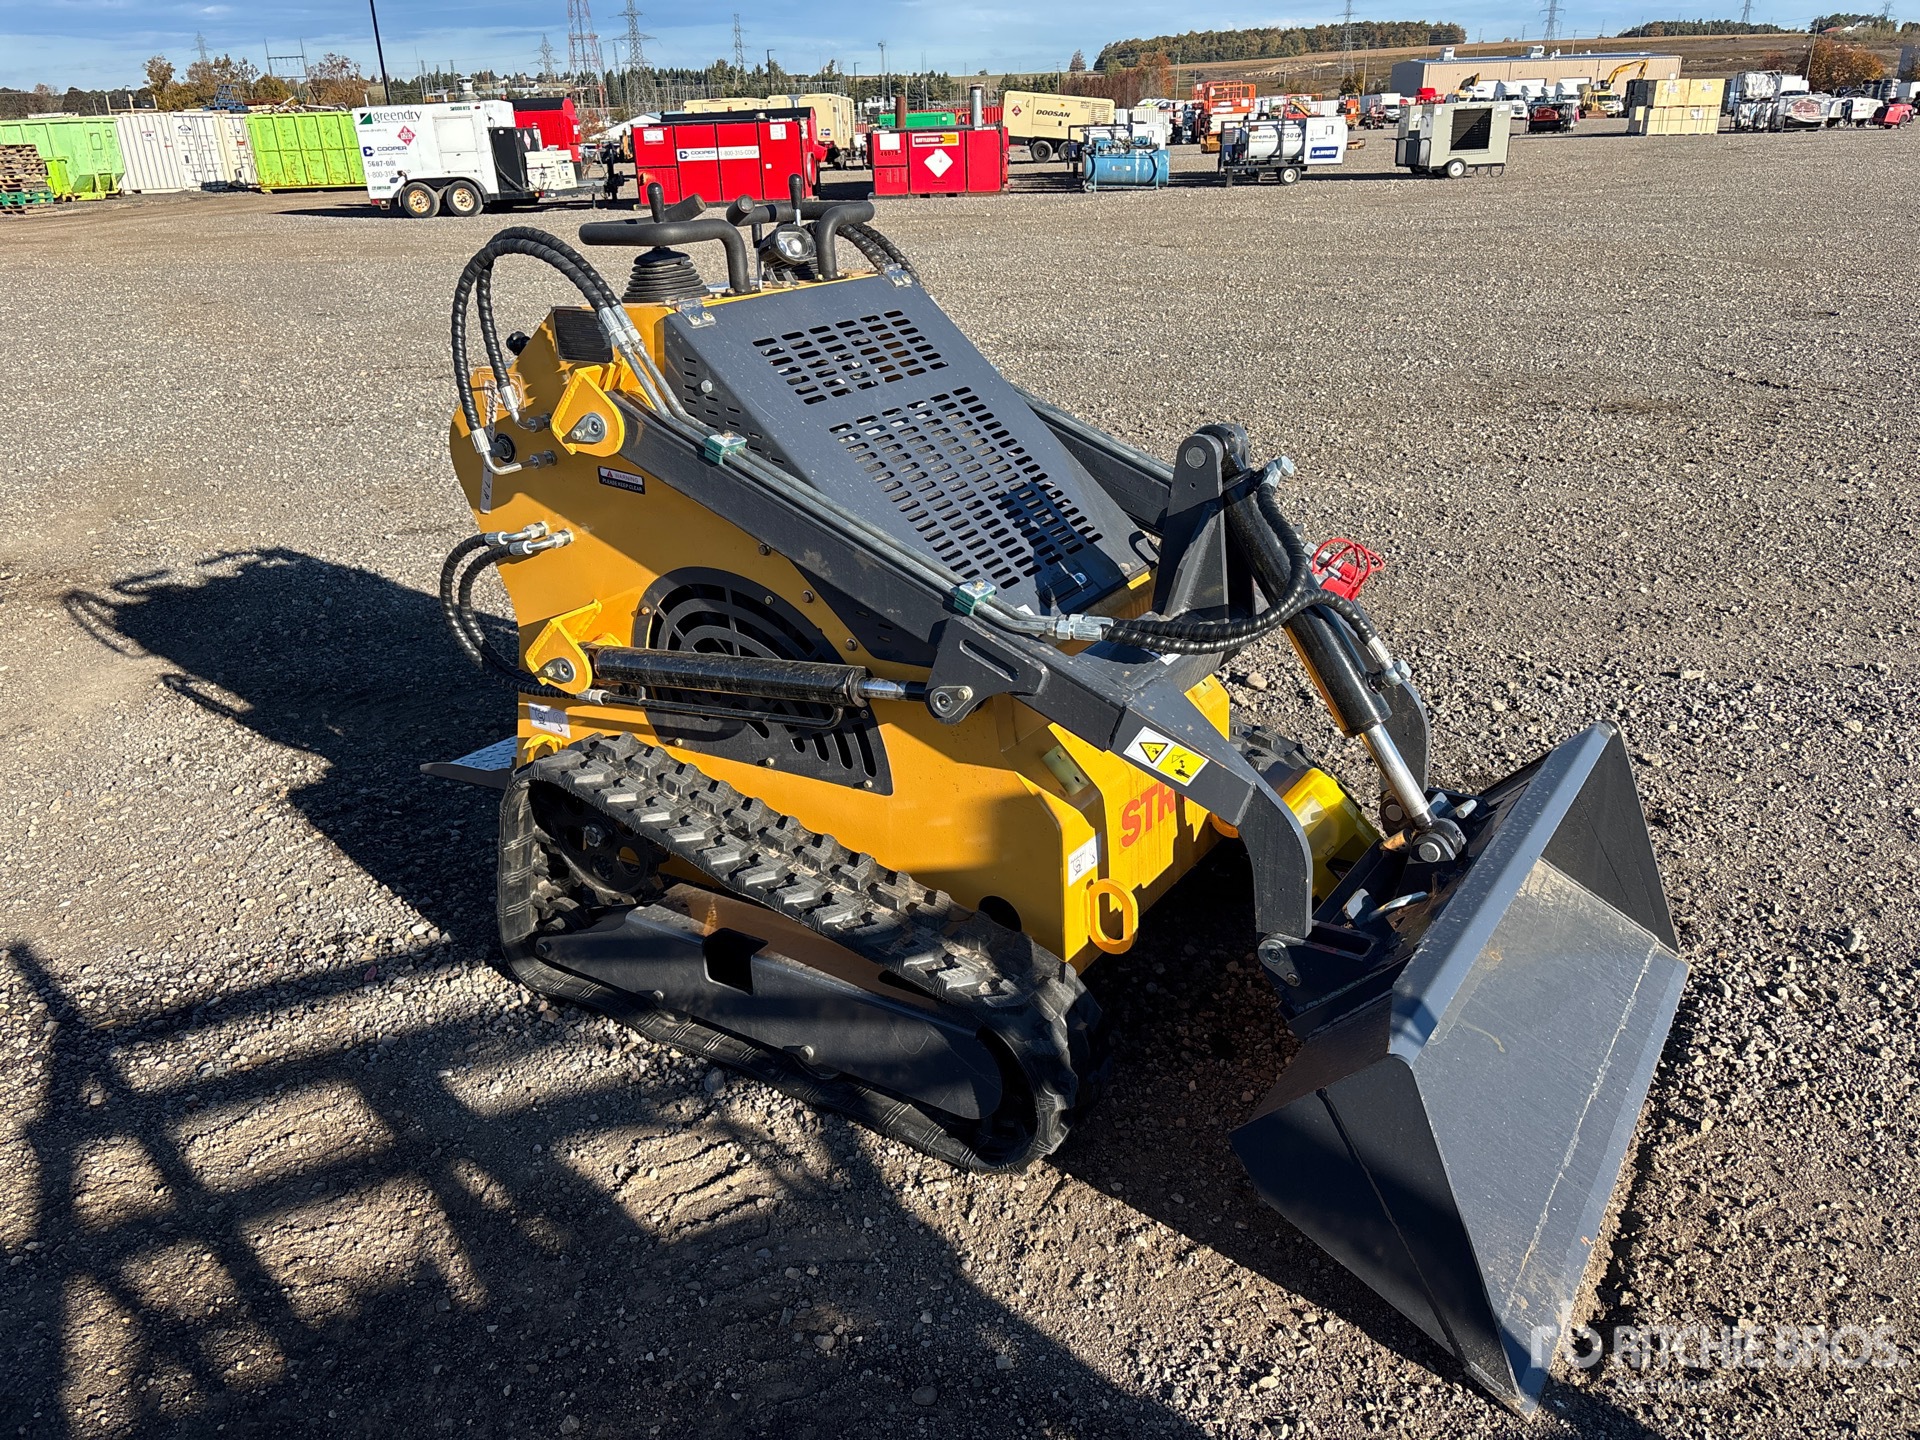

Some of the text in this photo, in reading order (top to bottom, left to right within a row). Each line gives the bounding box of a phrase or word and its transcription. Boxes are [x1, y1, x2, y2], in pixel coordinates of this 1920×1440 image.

[373, 110, 422, 124] greendry
[1036, 109, 1071, 118] DOOSAN
[720, 149, 757, 157] 1-800-315-COOP
[615, 473, 639, 483] WARNING
[602, 478, 617, 486] PLEASE
[628, 484, 642, 492] CLEAR
